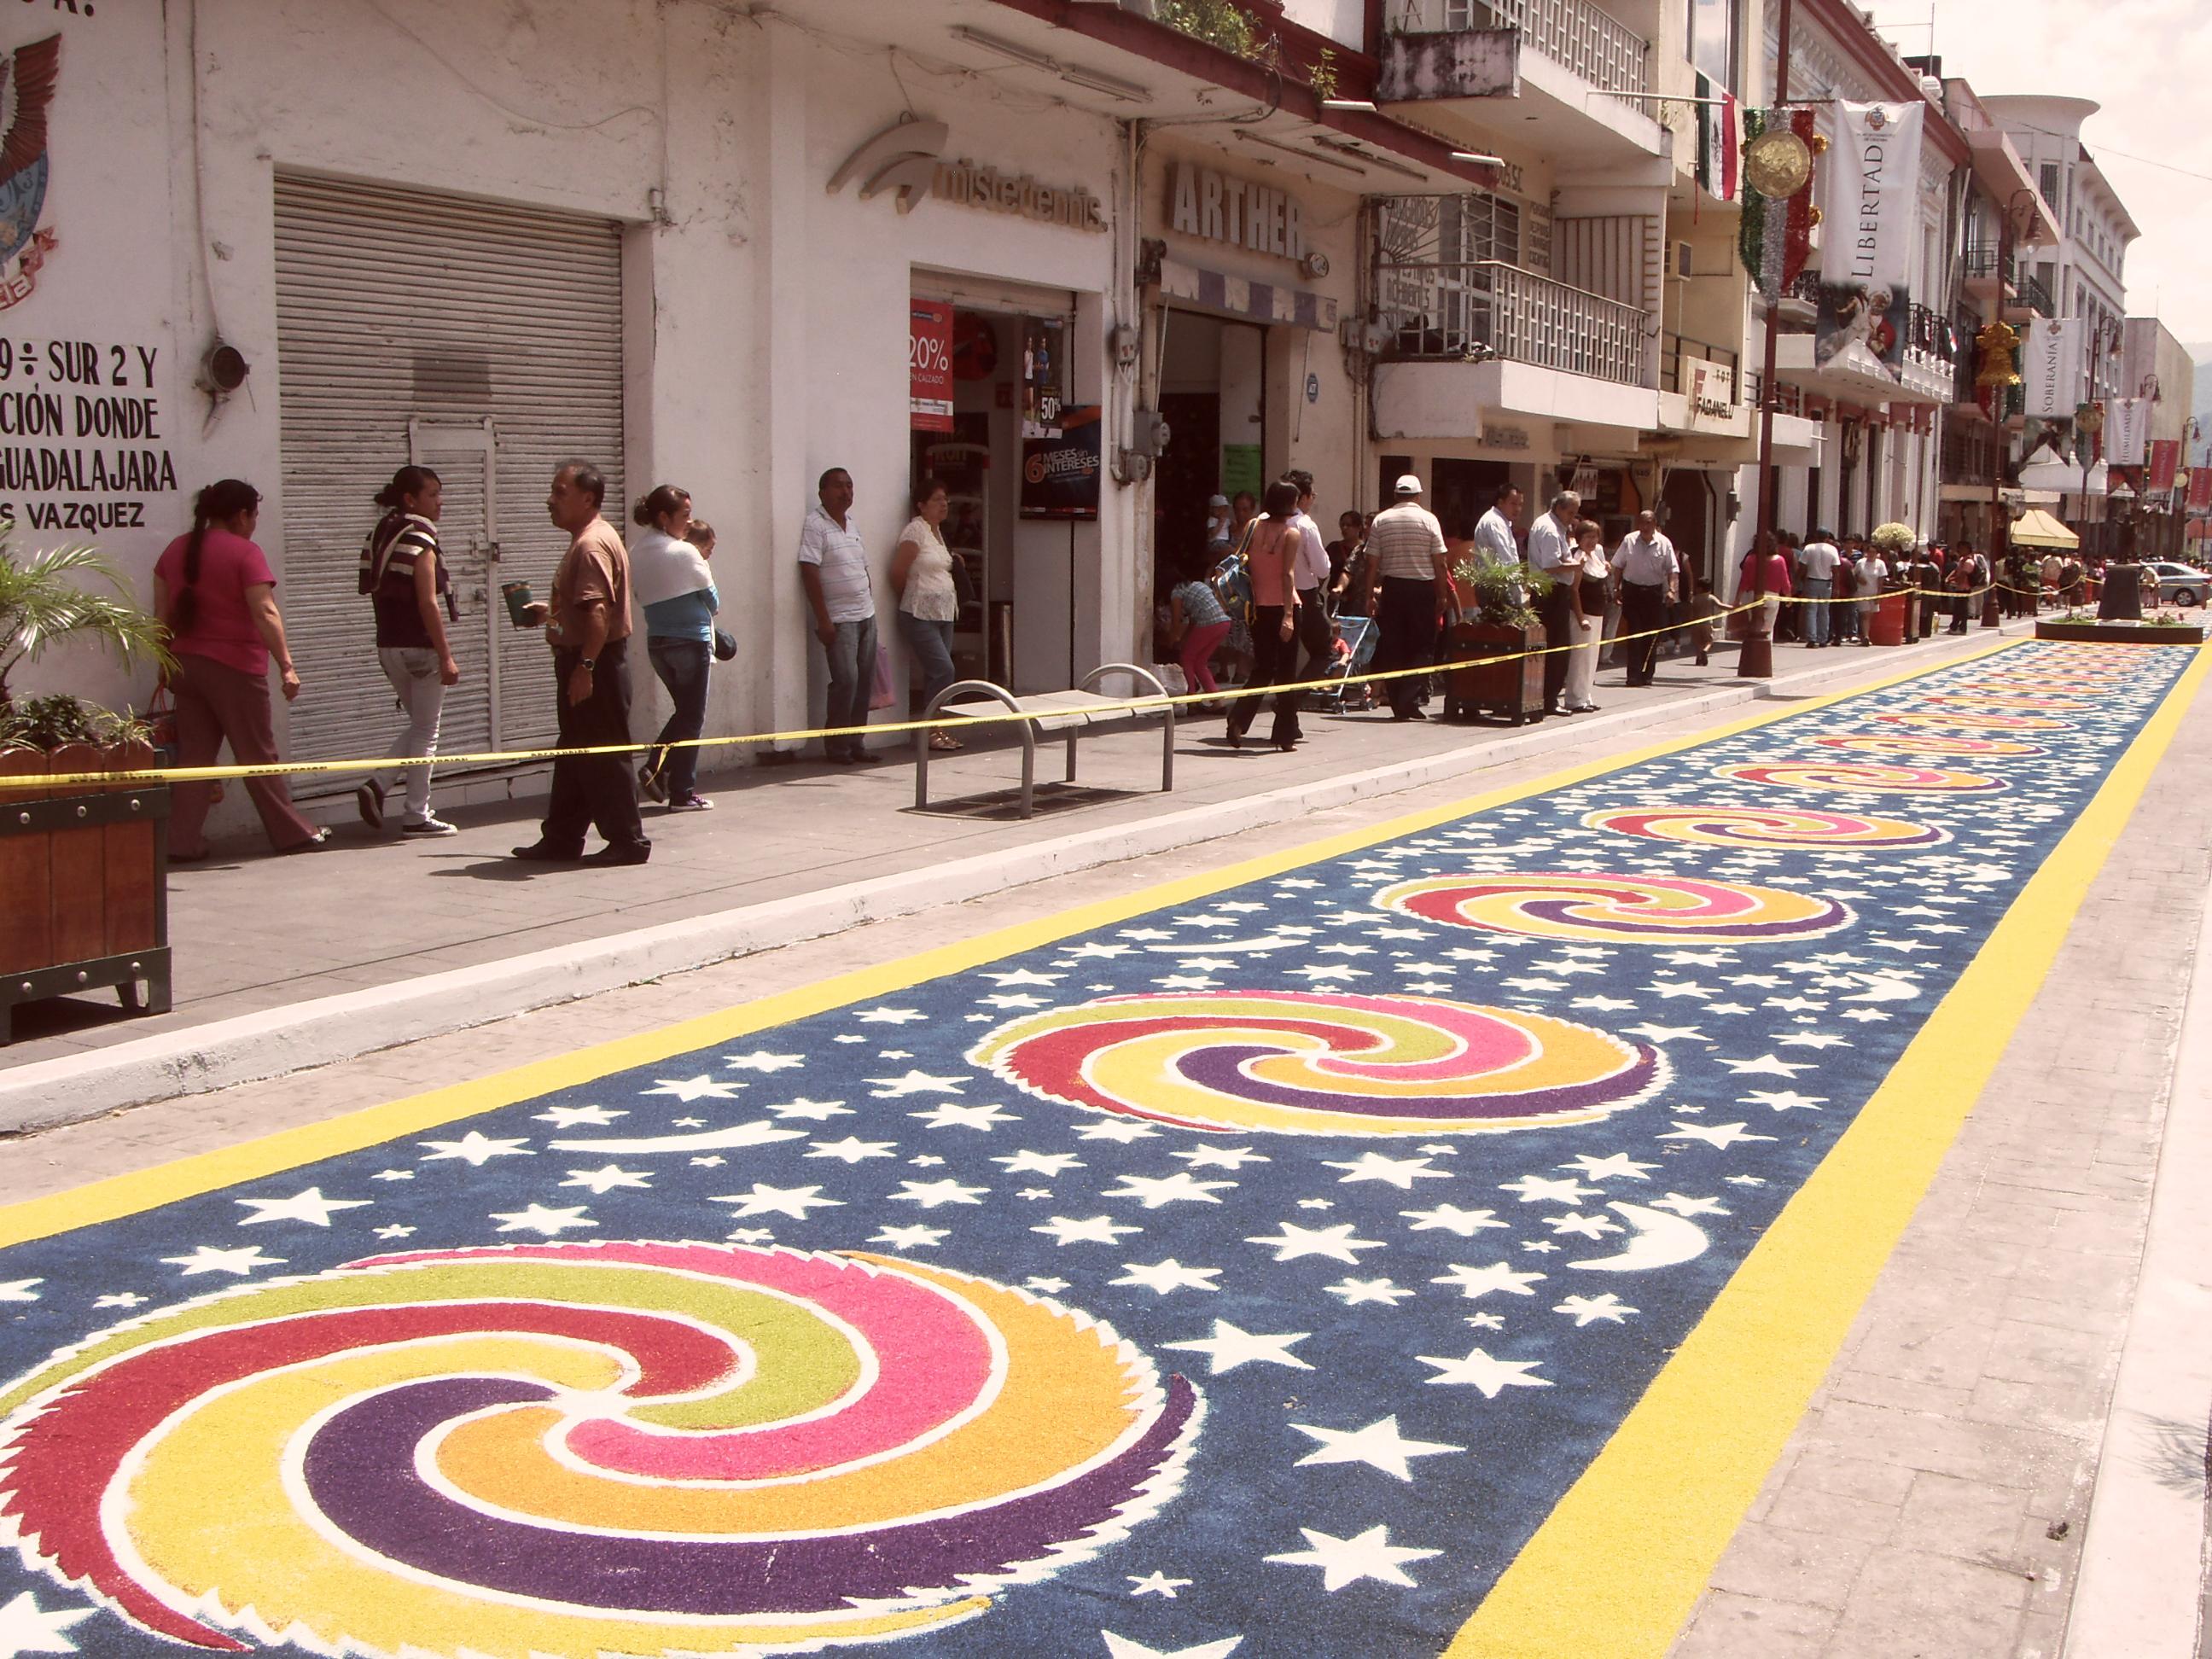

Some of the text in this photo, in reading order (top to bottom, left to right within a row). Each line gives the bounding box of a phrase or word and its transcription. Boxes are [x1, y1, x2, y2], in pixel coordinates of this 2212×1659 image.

[1172, 160, 1306, 261] ARTHER
[1850, 144, 1883, 278] LIBERTAD
[48, 341, 101, 385] SUR
[110, 345, 128, 386] 2
[137, 346, 158, 388] Y
[910, 335, 948, 371] 20%
[75, 395, 160, 439] DONDE
[1041, 397, 1062, 420] 50%
[1025, 453, 1045, 484] 6
[1043, 448, 1077, 463] MESES
[1044, 456, 1100, 474] INTERESES
[26, 502, 145, 535] VAZQUEZ
